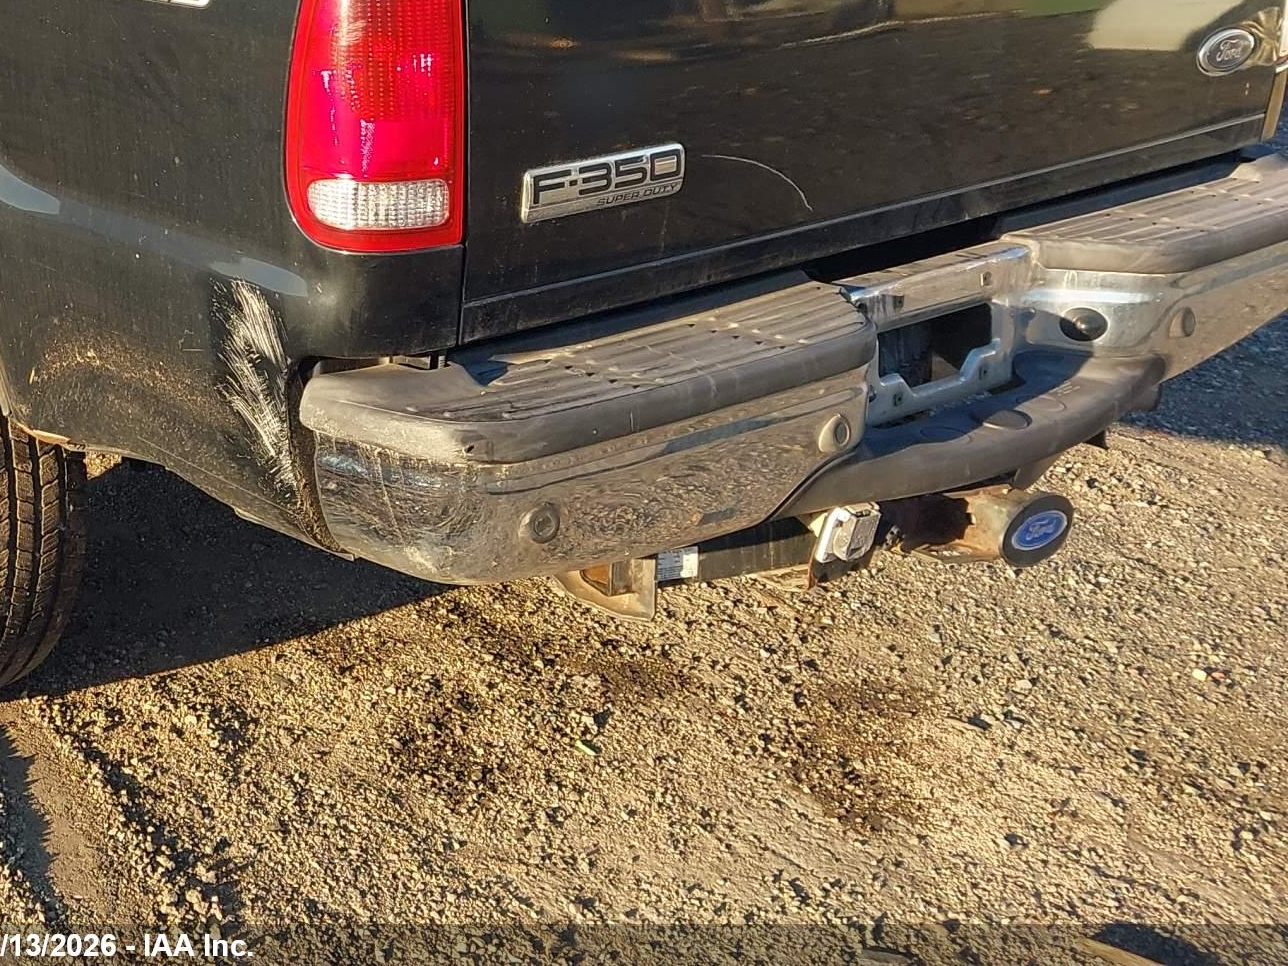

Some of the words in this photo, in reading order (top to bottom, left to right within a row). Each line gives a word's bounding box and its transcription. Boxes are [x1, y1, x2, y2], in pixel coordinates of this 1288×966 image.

[533, 148, 682, 205] F-350
[596, 191, 641, 206] SUPER
[643, 183, 679, 198] DUTY
